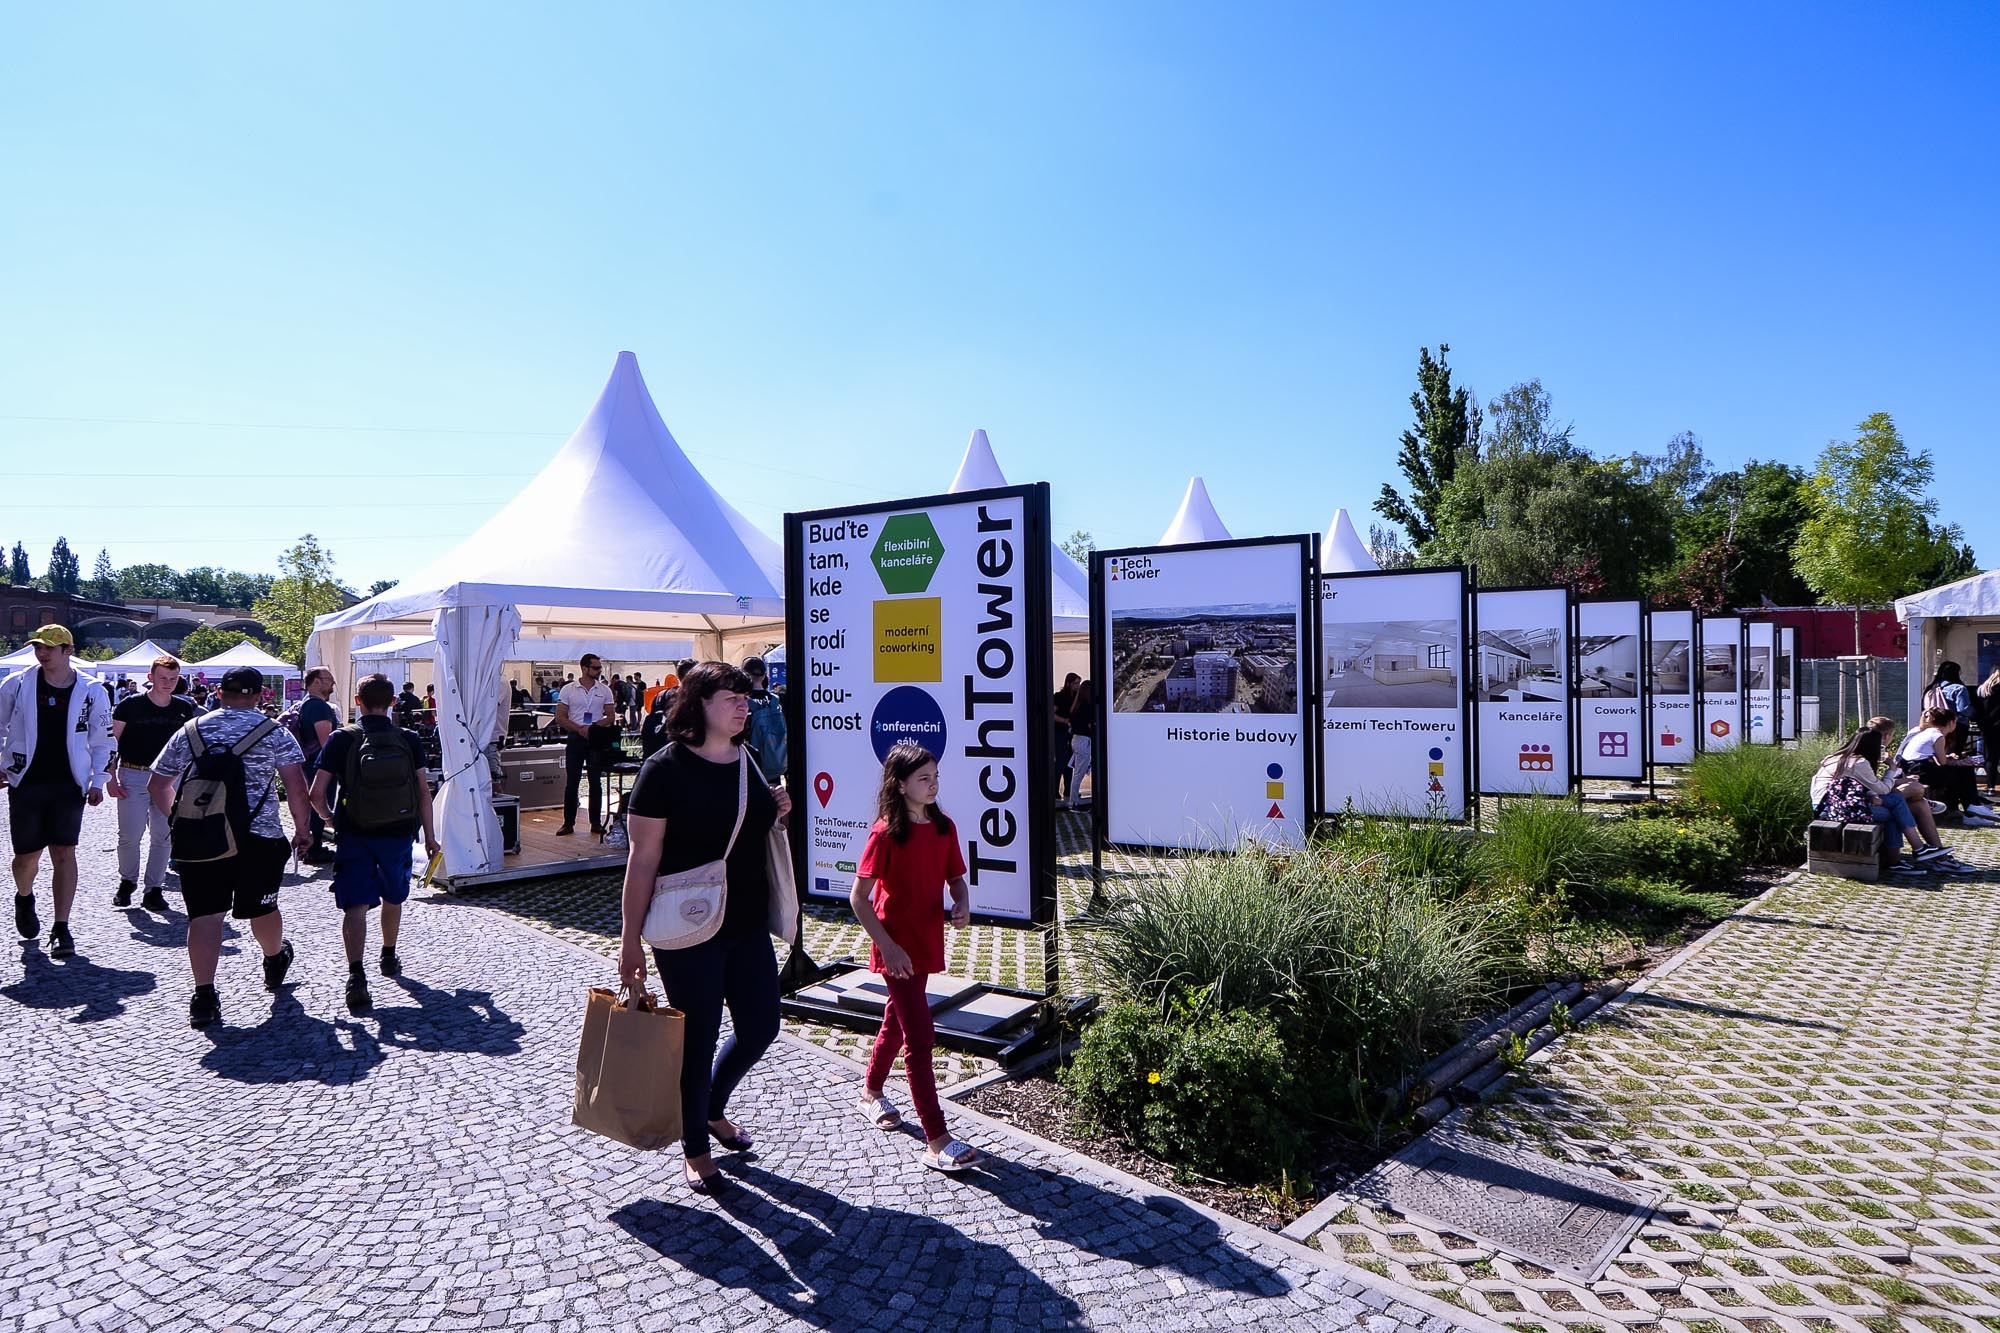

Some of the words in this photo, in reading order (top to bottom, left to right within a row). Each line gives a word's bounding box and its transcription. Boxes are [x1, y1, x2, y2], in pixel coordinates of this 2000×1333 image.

[809, 520, 869, 543] Buďte
[884, 538, 930, 552] flexibilní
[809, 552, 849, 570] tam,
[880, 554, 933, 568] kanceláře
[1120, 556, 1152, 569] Tech
[1120, 569, 1160, 580] Tower
[809, 576, 842, 597] kde
[810, 607, 830, 623] se
[885, 625, 929, 638] moderní
[811, 629, 847, 649] rodí
[879, 641, 935, 655] coworking
[811, 658, 840, 677] bu-
[811, 684, 852, 703] dou-
[964, 505, 1017, 886] TechTower
[1594, 706, 1637, 715] Cowork
[1660, 701, 1690, 710] Space
[811, 712, 862, 731] cnost
[1499, 711, 1563, 721] Kanceláře
[1370, 719, 1456, 732] TechToweru
[1167, 727, 1230, 741] Historie
[1235, 728, 1297, 746] budovy
[814, 816, 868, 829] TechTower.cz
[814, 827, 853, 840] Světovar,
[814, 838, 847, 851] Slovany
